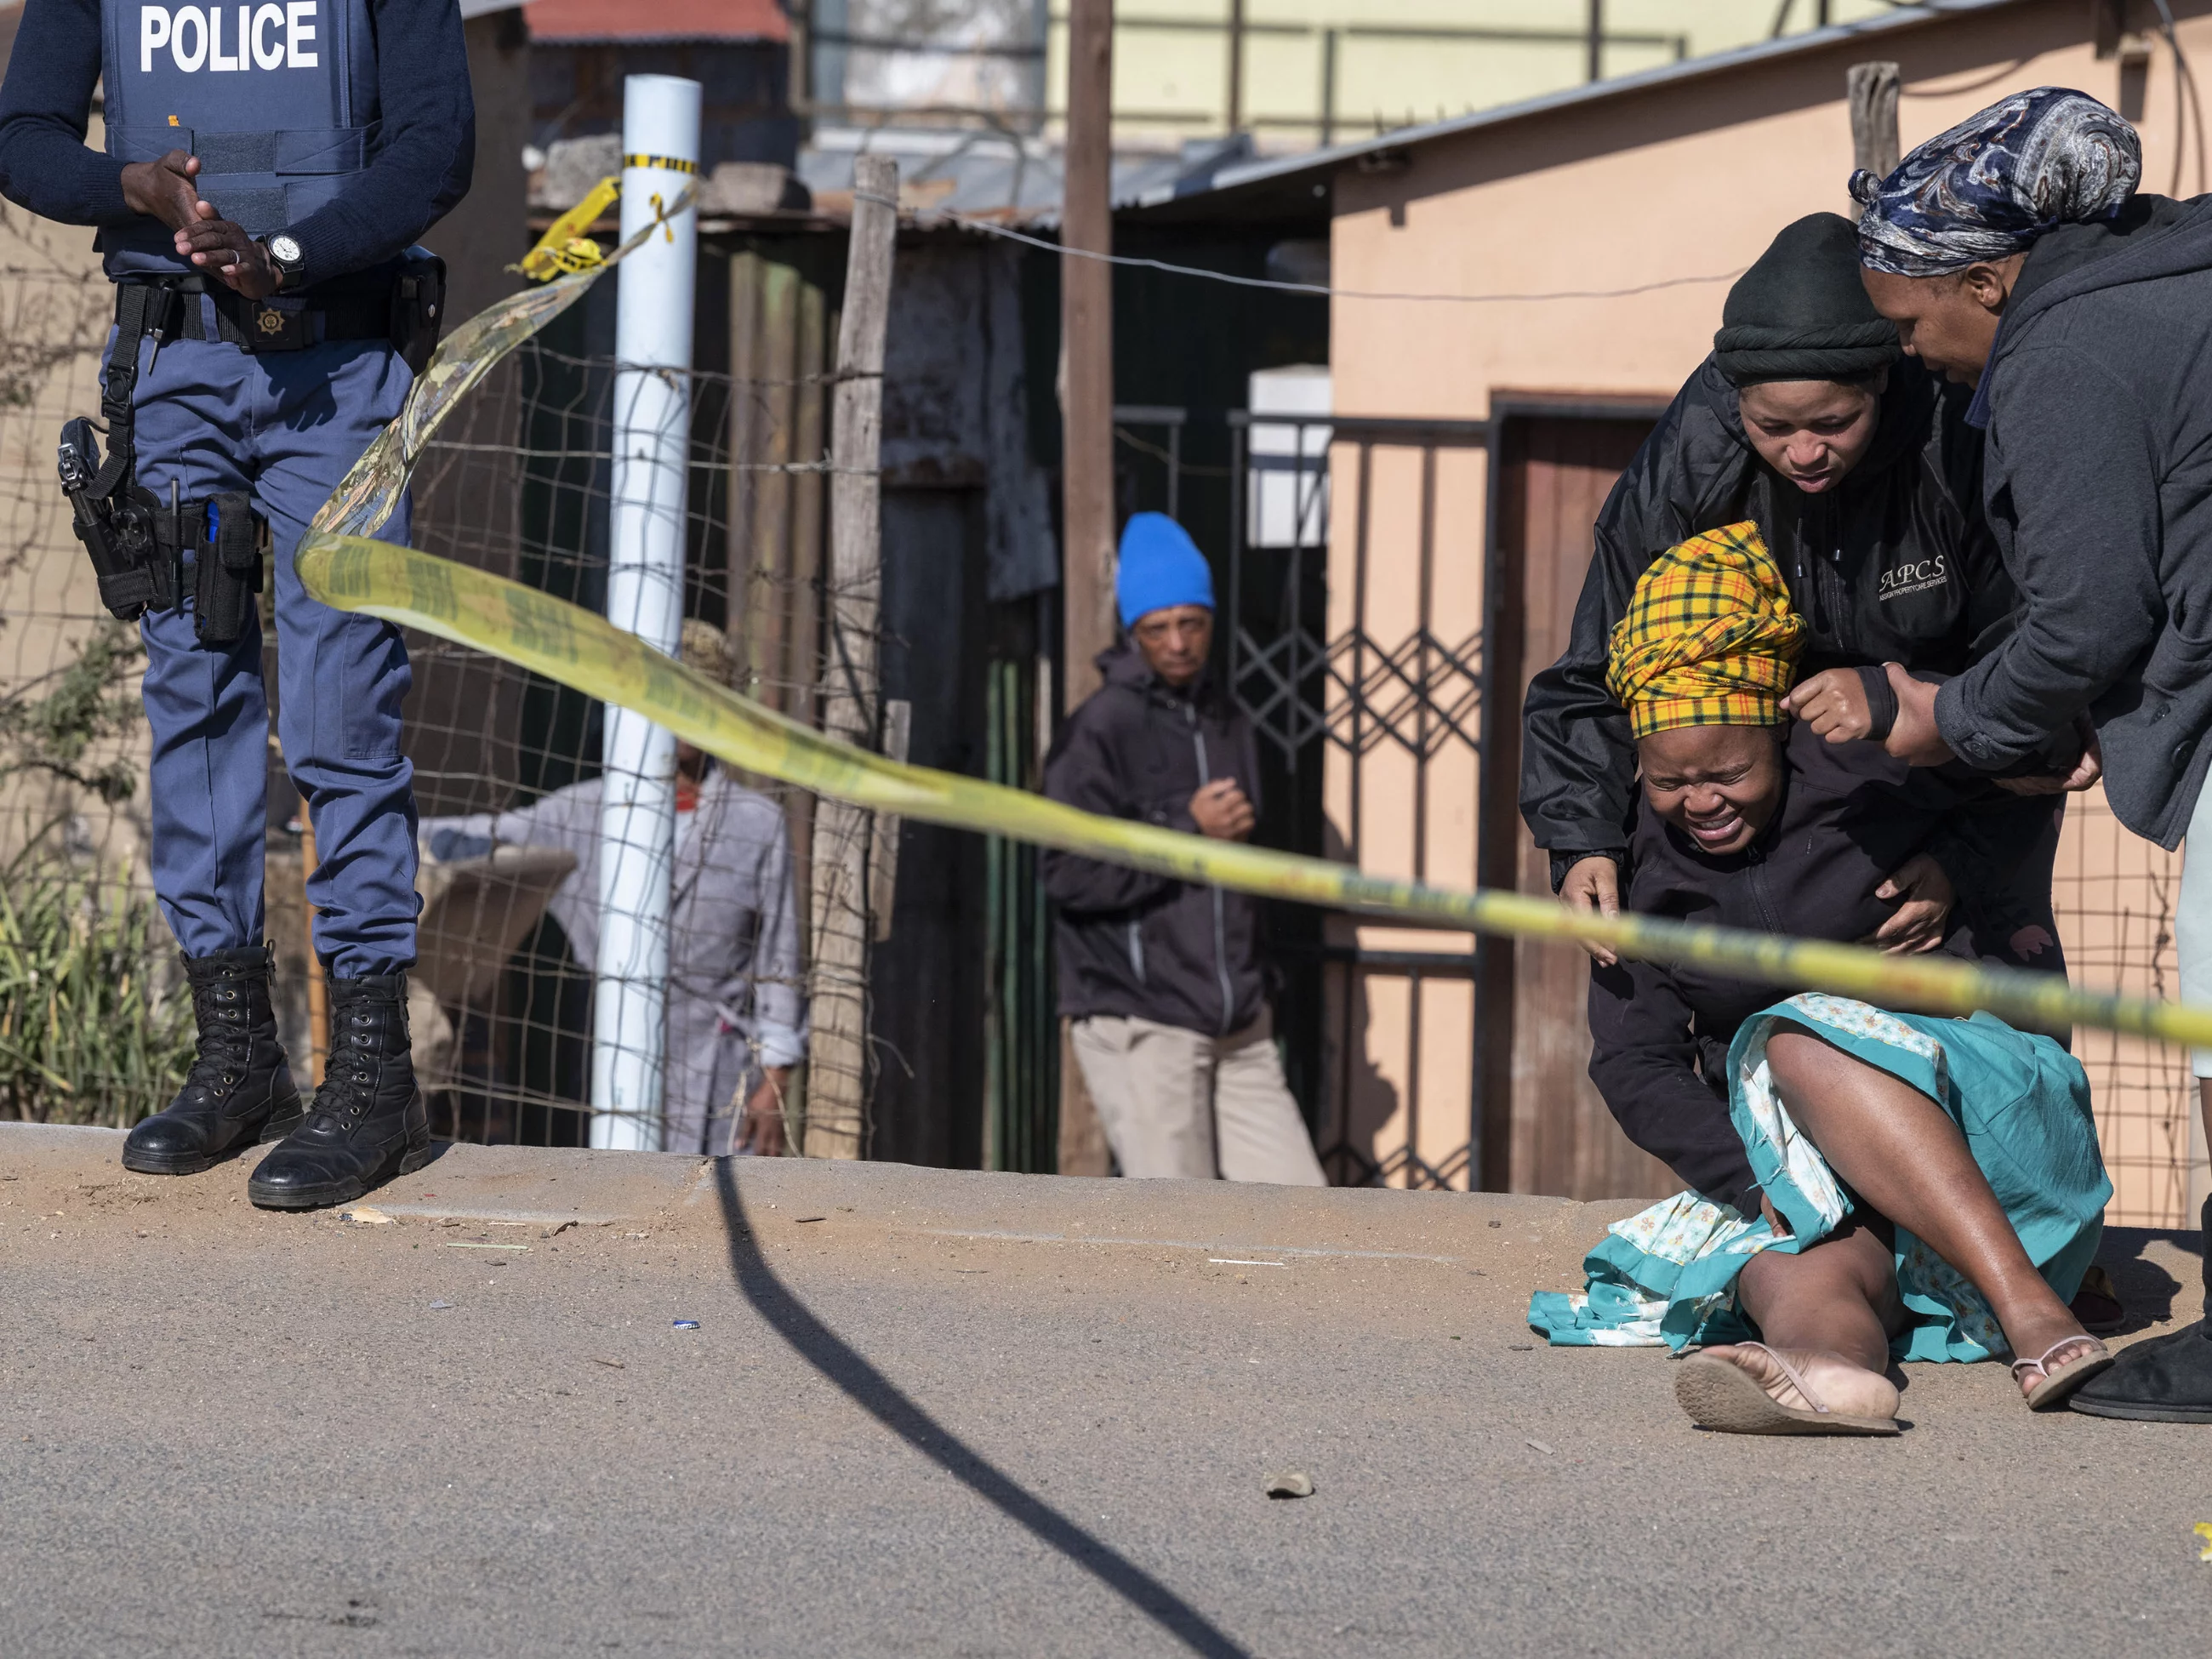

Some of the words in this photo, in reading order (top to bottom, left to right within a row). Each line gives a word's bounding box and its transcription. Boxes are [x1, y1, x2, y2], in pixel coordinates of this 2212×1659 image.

[140, 1, 318, 72] POLICE
[1878, 555, 1944, 593] APCS
[1893, 584, 1916, 596] PROPERTY
[1915, 582, 1927, 591] CARE
[1926, 575, 1947, 587] SERVICES
